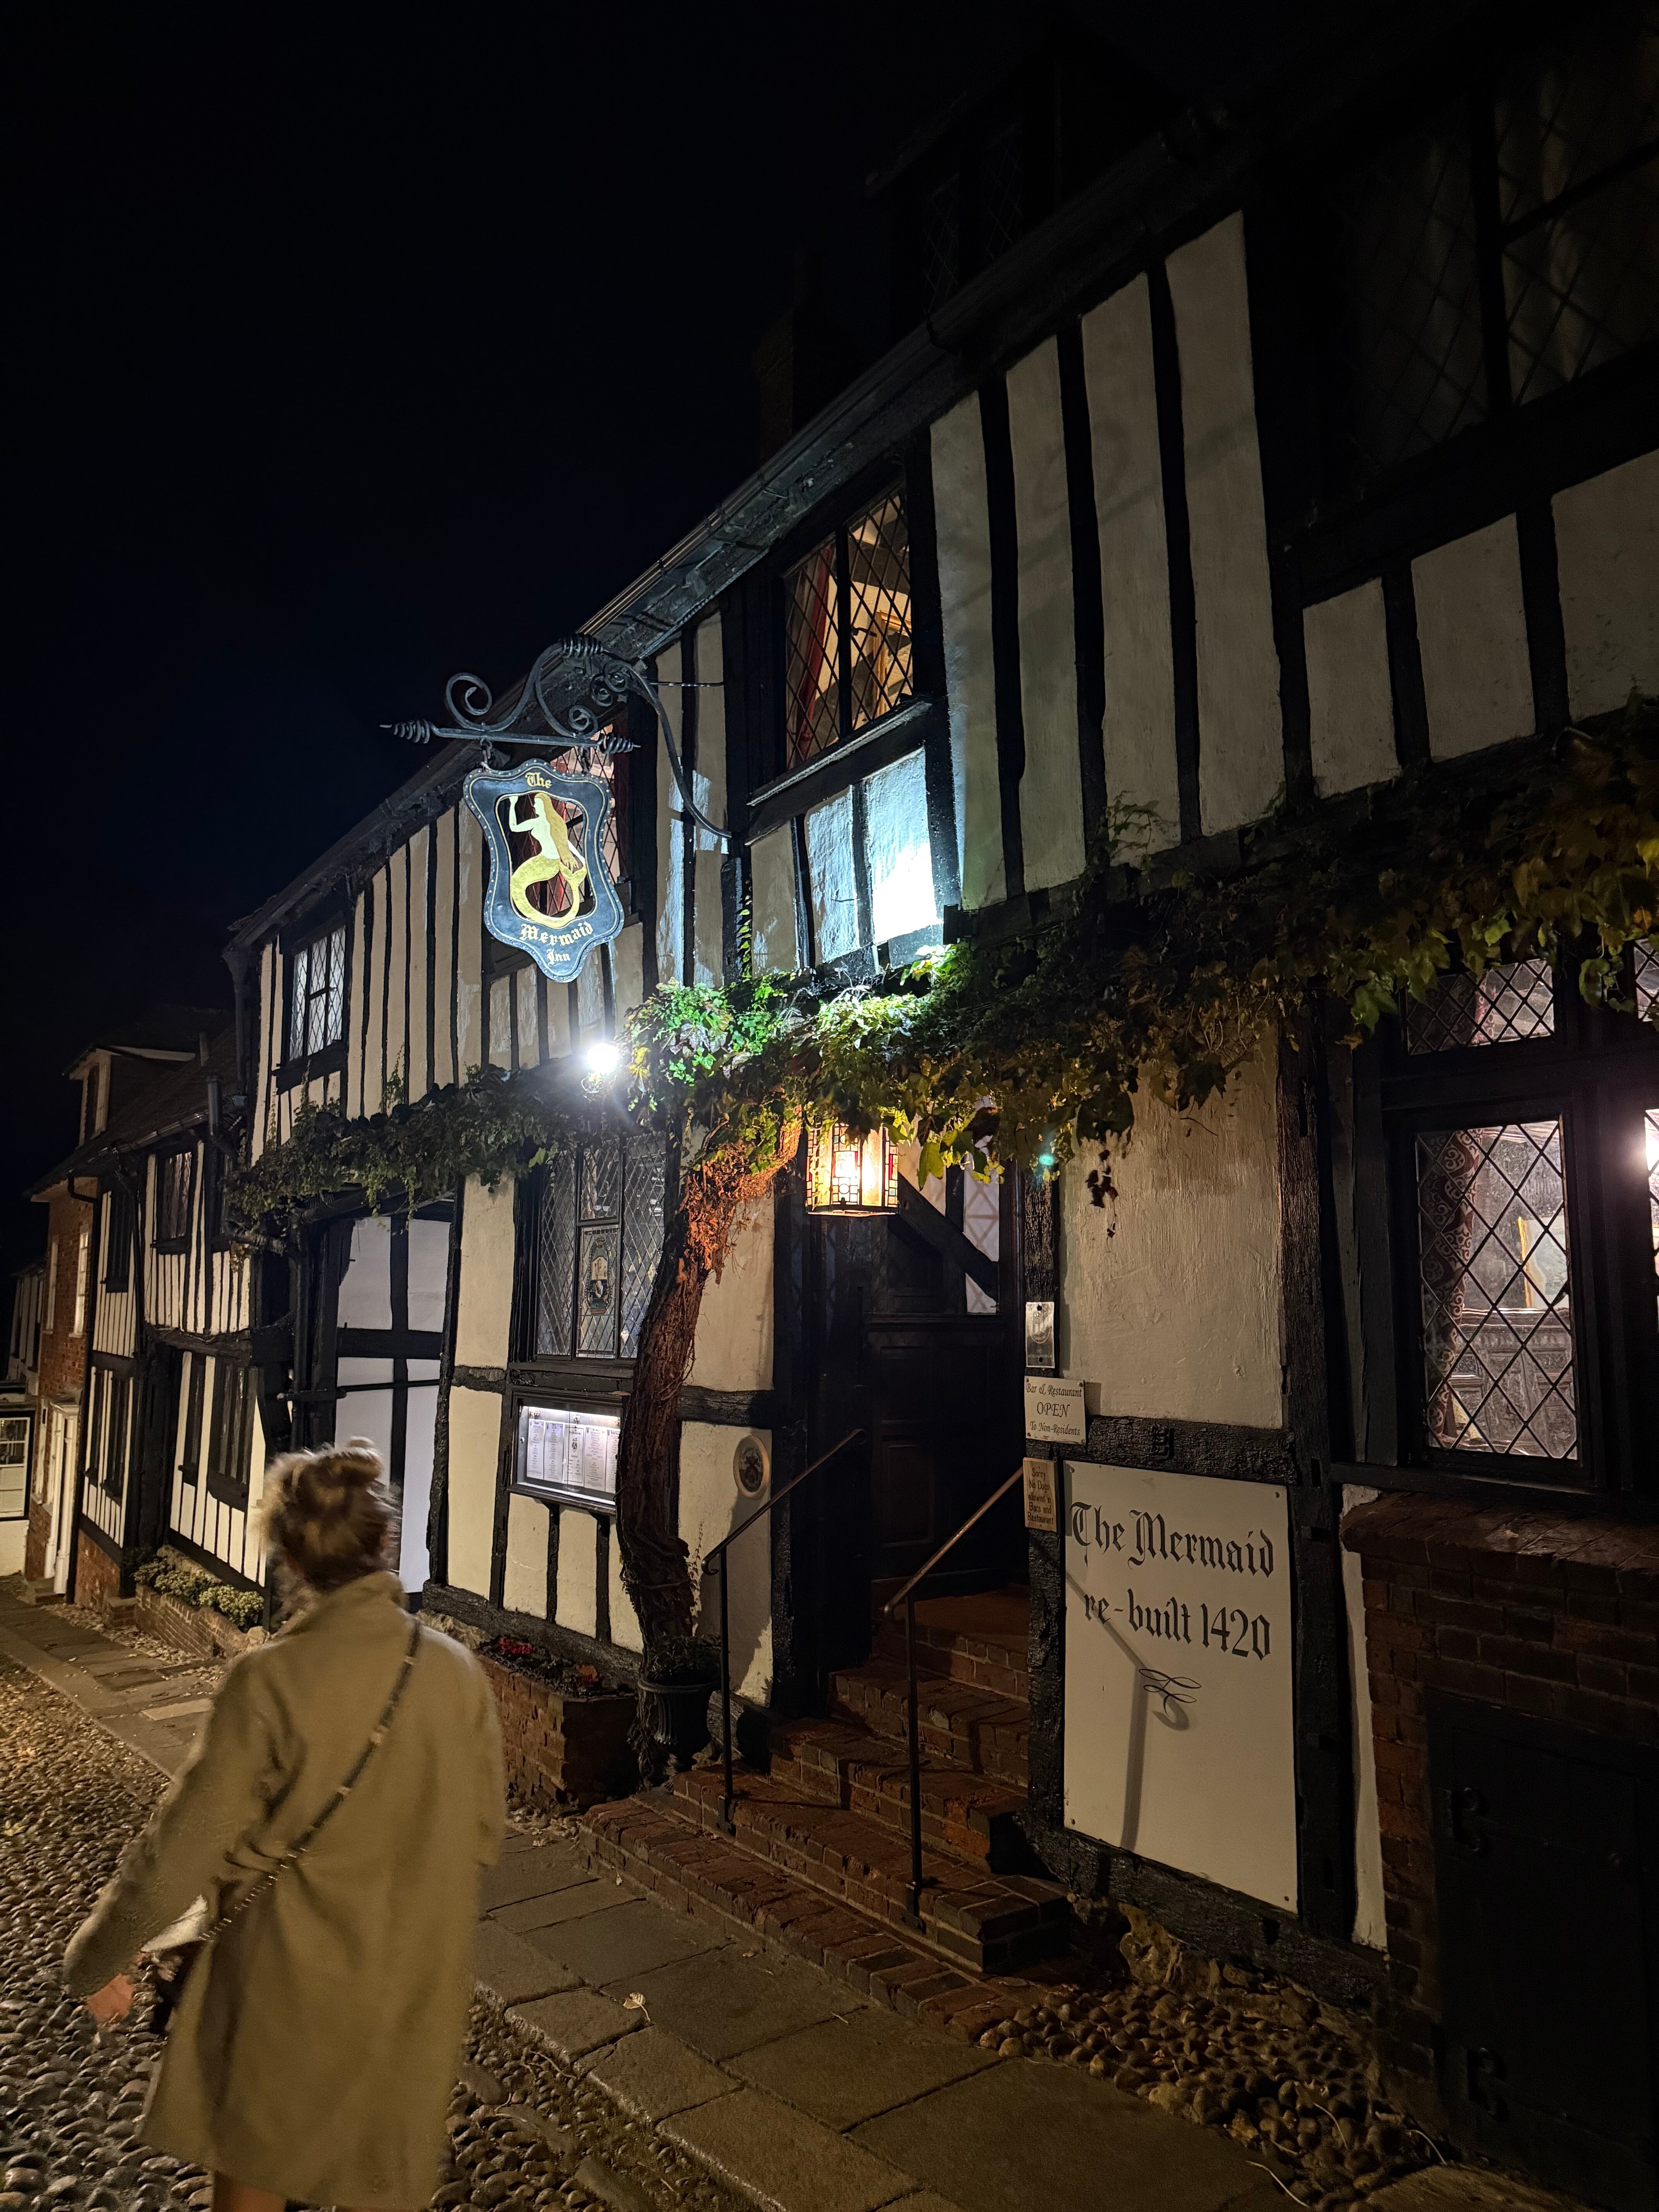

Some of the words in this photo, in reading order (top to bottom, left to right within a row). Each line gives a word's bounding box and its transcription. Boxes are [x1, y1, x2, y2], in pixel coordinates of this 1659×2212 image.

[525, 772, 552, 788] The
[519, 921, 593, 946] Mermaid
[547, 949, 570, 966] Inn
[1026, 1383, 1037, 1393] Bar
[1039, 1384, 1046, 1395] &
[1048, 1385, 1082, 1397] Restaurant
[1037, 1402, 1070, 1417] OPEN
[1030, 1421, 1037, 1430] To
[1039, 1422, 1080, 1436] Non-Residents
[1032, 1468, 1046, 1480] Sorry
[1029, 1479, 1036, 1489] No
[1038, 1480, 1050, 1493] Dogs
[1029, 1492, 1045, 1503] allowed
[1029, 1502, 1041, 1512] Bars
[1043, 1505, 1051, 1514] and
[1028, 1511, 1053, 1524] Restaurant
[1070, 1501, 1125, 1568] The
[1127, 1510, 1274, 1577] Mermaid
[1084, 1588, 1191, 1644] re-built
[1200, 1603, 1271, 1661] 1420
